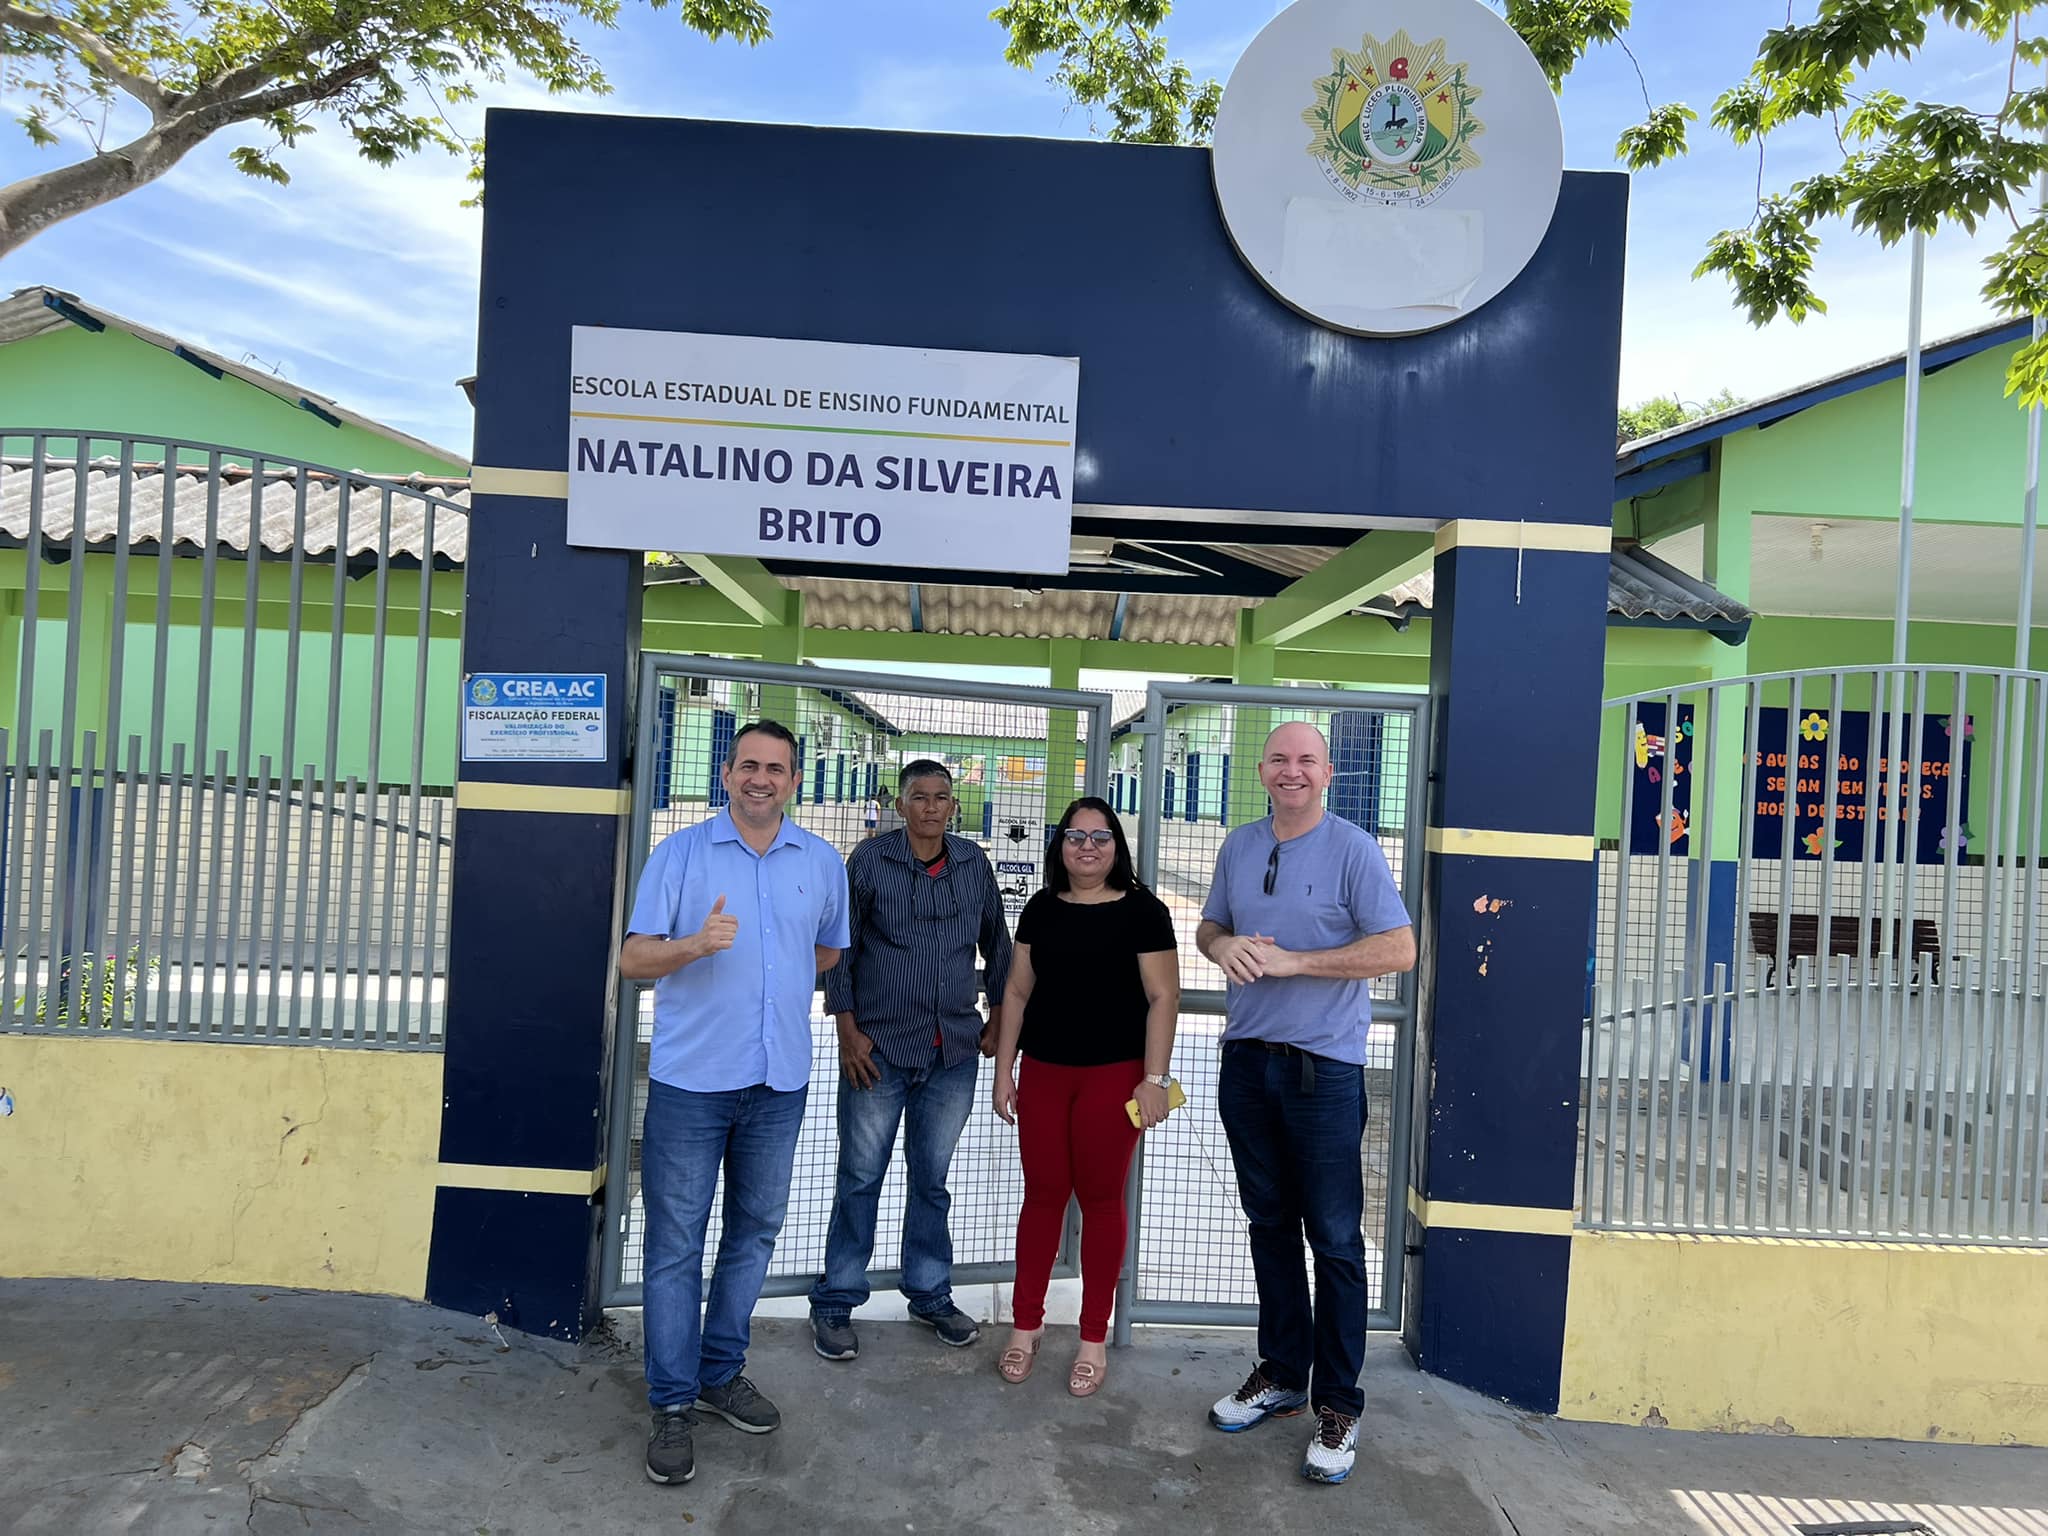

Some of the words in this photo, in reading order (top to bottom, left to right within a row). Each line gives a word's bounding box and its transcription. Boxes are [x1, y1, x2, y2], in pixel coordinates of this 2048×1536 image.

[1363, 91, 1382, 118] LUCEO
[1385, 85, 1423, 112] PLURIBUS
[1362, 122, 1370, 141] NEC
[1414, 115, 1425, 144] IMPAR
[571, 376, 657, 399] ESCOLA
[665, 382, 776, 406] ESTADUAL
[783, 389, 811, 408] DE
[819, 392, 901, 414] ENSINO
[908, 397, 1070, 423] FUNDAMENTAL
[577, 438, 793, 484] NATALINO
[807, 452, 864, 488] DA
[875, 456, 1062, 500] SILVEIRA
[758, 507, 881, 547] BRITO
[502, 680, 595, 697] CREA-AC
[469, 709, 548, 722] FISCALIZAÇÃO
[552, 711, 600, 720] FEDERAL
[1766, 752, 1820, 769] AUAS
[1767, 776, 1820, 793] SEAM
